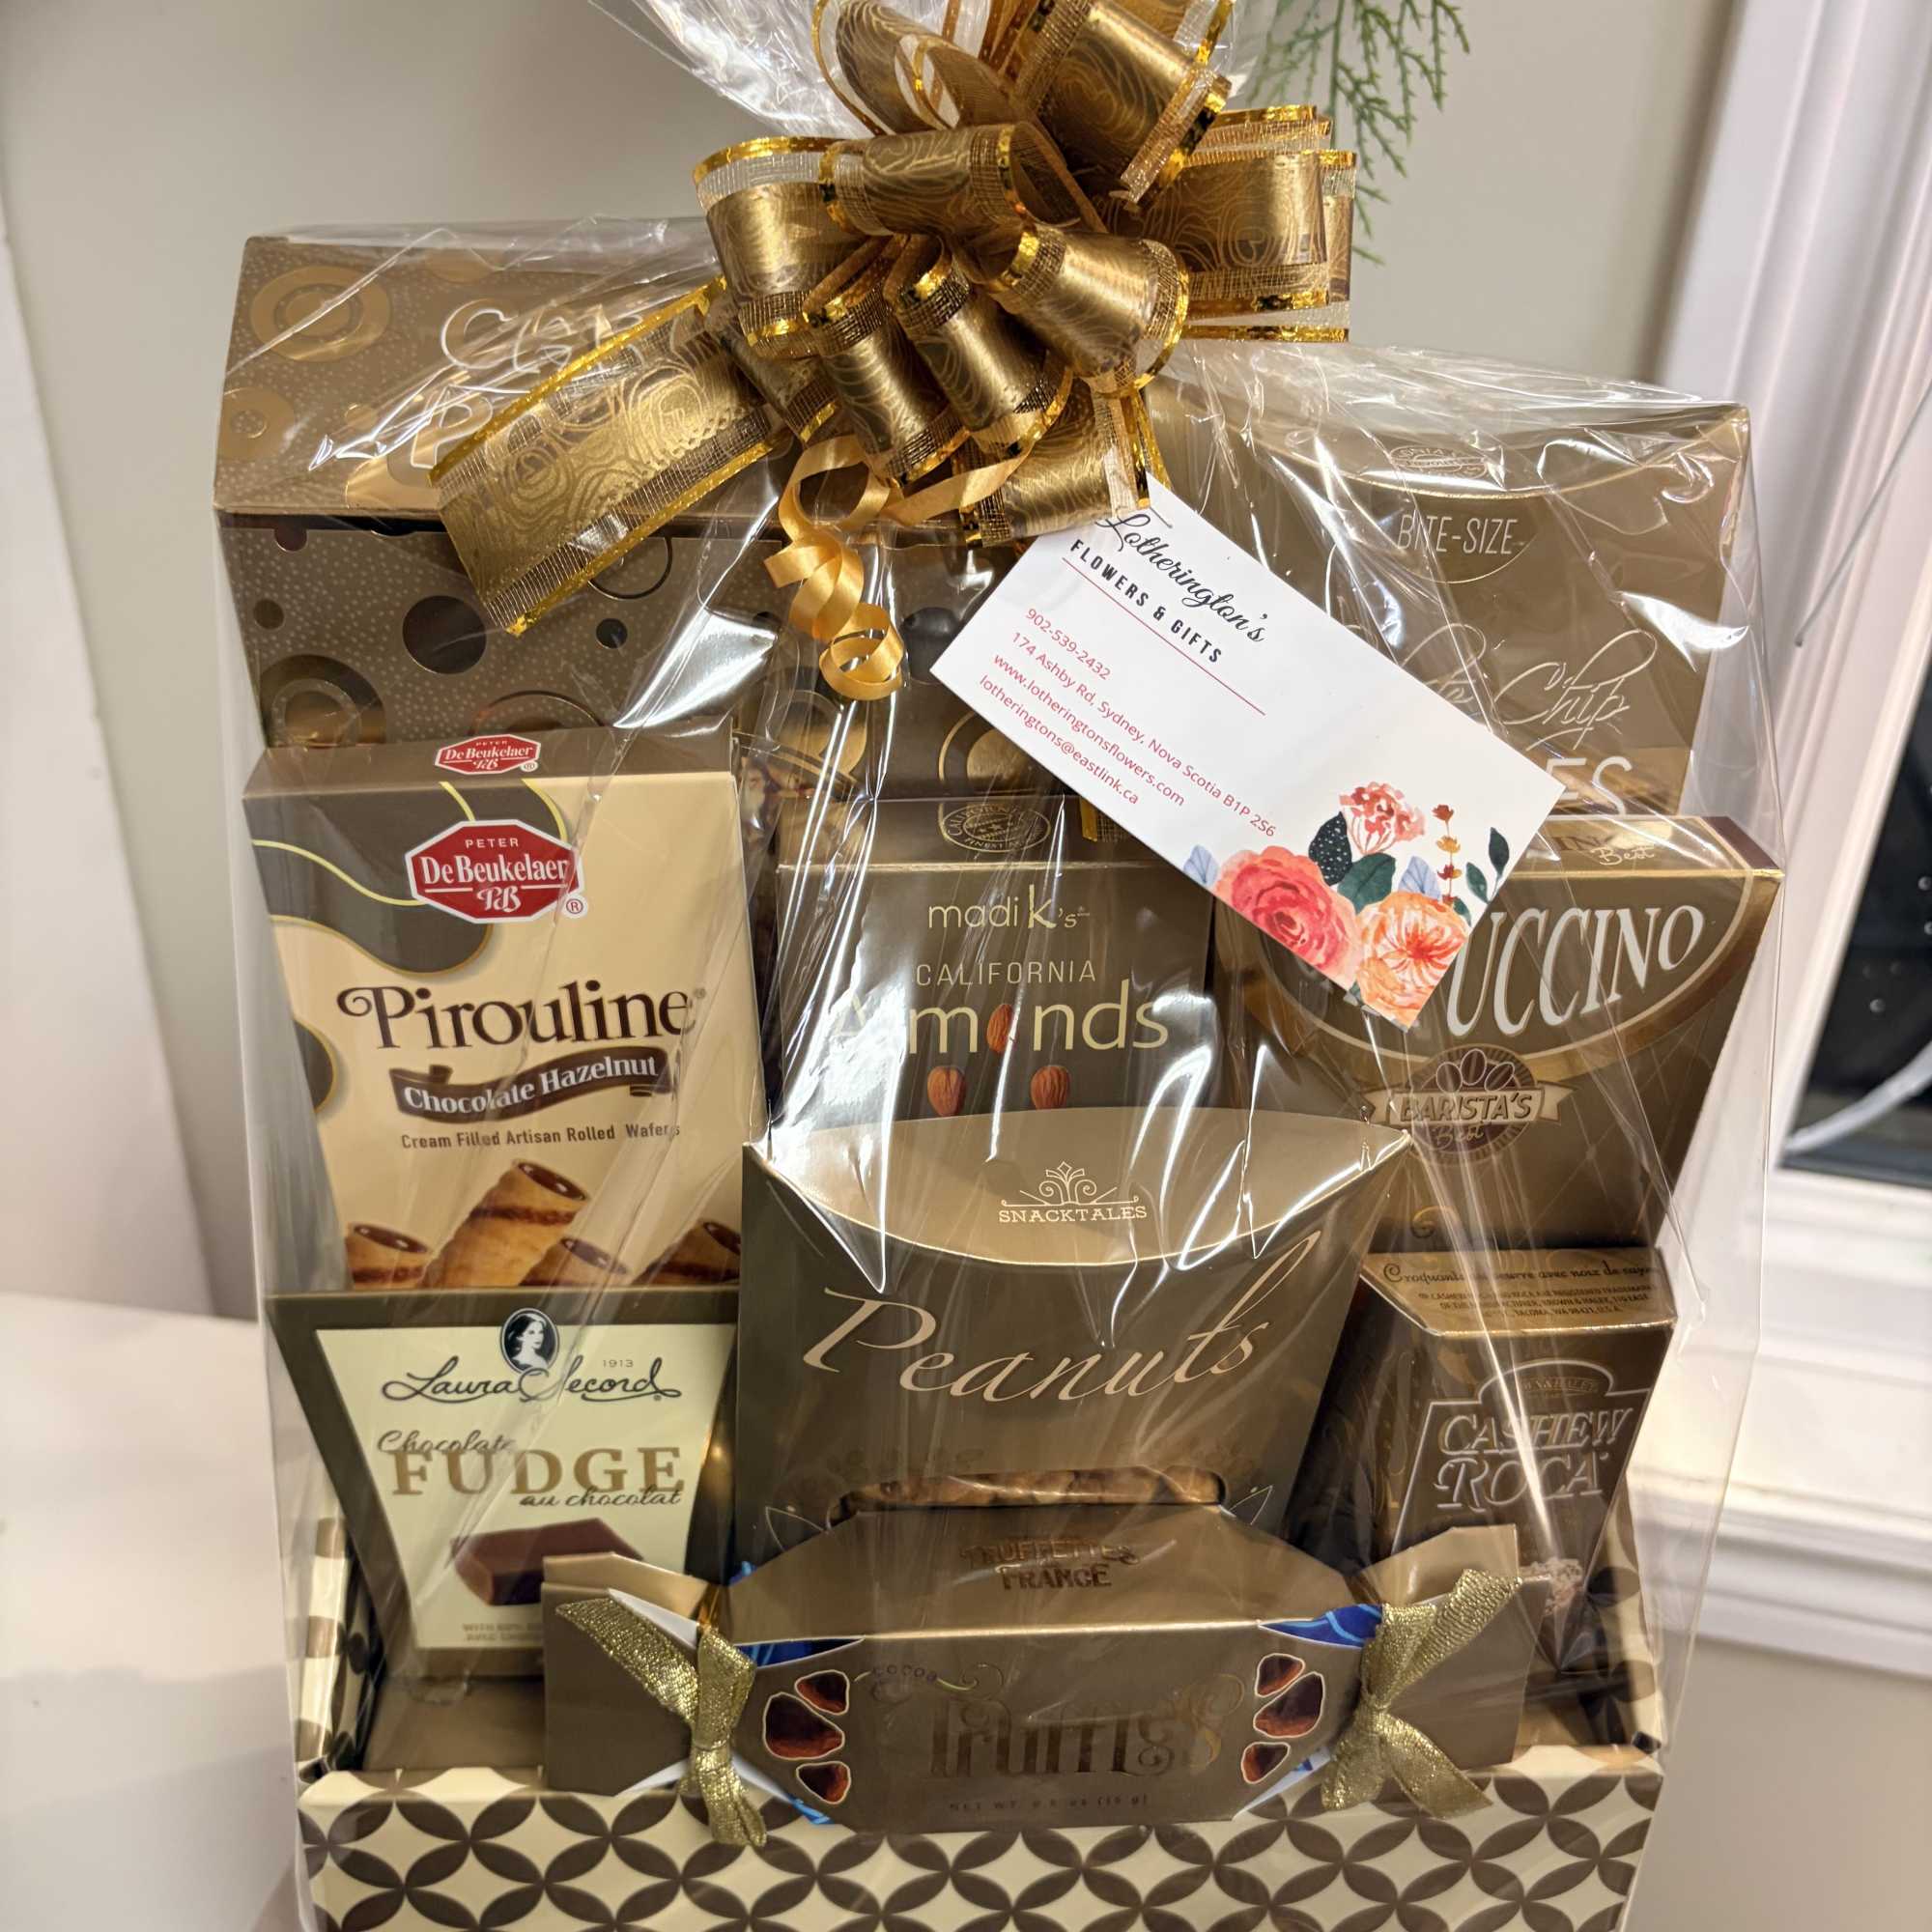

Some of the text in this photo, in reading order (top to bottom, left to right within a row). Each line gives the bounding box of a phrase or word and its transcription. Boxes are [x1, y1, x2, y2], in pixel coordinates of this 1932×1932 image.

[1398, 514, 1518, 554] BITE-SIZE
[1070, 538, 1222, 663] FLOWERS & GIFTS
[1094, 513, 1267, 642] Lotherington's
[1026, 608, 1112, 680] 902-539-2432
[980, 674, 1139, 805] lotheringtons@eastlink.ca
[993, 654, 1186, 807] www.lotheringtonsflowers.com
[1012, 632, 1276, 838] 174 Ashby Rd, Sydney, Nova Scotia B1P 2S6
[466, 837, 519, 848] PETER
[916, 959, 1096, 986] CALIFORNIA
[1446, 904, 1705, 1037] UCCINO
[336, 979, 695, 1050] Pirouline
[404, 1055, 658, 1114] Chocolate Hazelnut
[1401, 1092, 1532, 1122] BARISTA'S
[401, 1122, 680, 1149] Cream Filled Artisan Rolled Wafers
[999, 1205, 1148, 1224] SNACKTALES
[802, 1229, 1322, 1404] Peanuts
[381, 1354, 682, 1404] Laura Secord
[602, 1359, 634, 1369] 1913
[1438, 1407, 1634, 1456] CASHEW
[386, 1446, 685, 1496] FUDGE
[519, 1485, 682, 1507] au chocolat
[1434, 1451, 1605, 1514] ROCA
